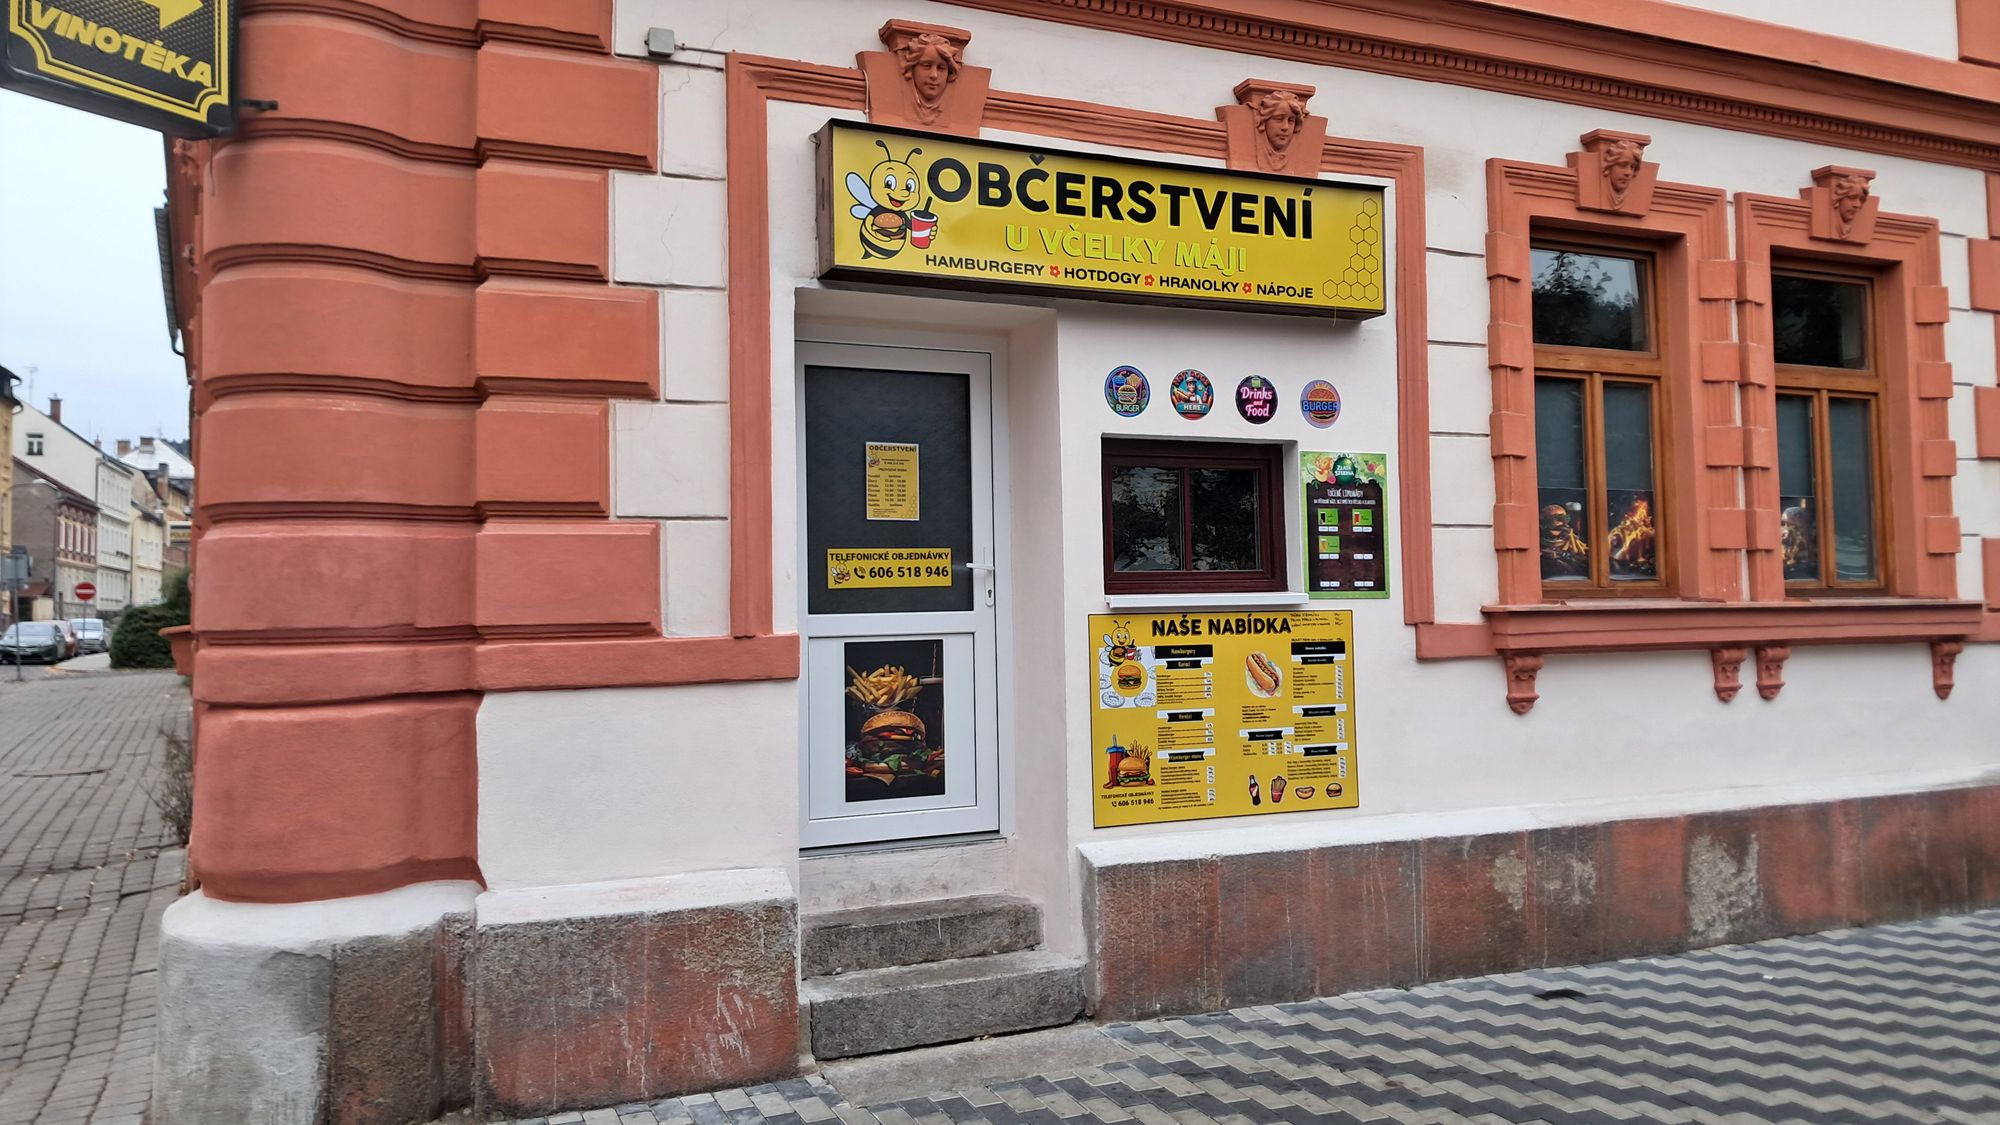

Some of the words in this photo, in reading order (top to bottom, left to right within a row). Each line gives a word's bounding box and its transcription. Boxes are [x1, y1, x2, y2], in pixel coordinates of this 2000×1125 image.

[31, 0, 212, 87] VINOTÉKA
[927, 153, 1313, 239] OBČERSTVENÍ
[1006, 224, 1029, 251] U
[1039, 223, 1166, 264] VČELKY
[1175, 238, 1247, 277] MÁJI
[925, 254, 1045, 276] HAMBURGERY
[1064, 267, 1142, 285] HOTDOGY
[1159, 275, 1239, 293] HRANOLKY
[1256, 282, 1314, 299] NÁPOJE
[1239, 386, 1273, 400] Drinks
[1116, 403, 1140, 412] BURGER
[1245, 403, 1270, 417] Food
[1302, 401, 1339, 411] BURGER
[829, 551, 889, 561] TELEFONICKÉ
[892, 550, 950, 560] OBJEDNÁVKY
[869, 566, 893, 578] 606
[897, 566, 921, 578] 518
[925, 565, 949, 577] 946
[1151, 613, 1202, 637] NAŠE
[1208, 613, 1291, 636] NABÍDKA
